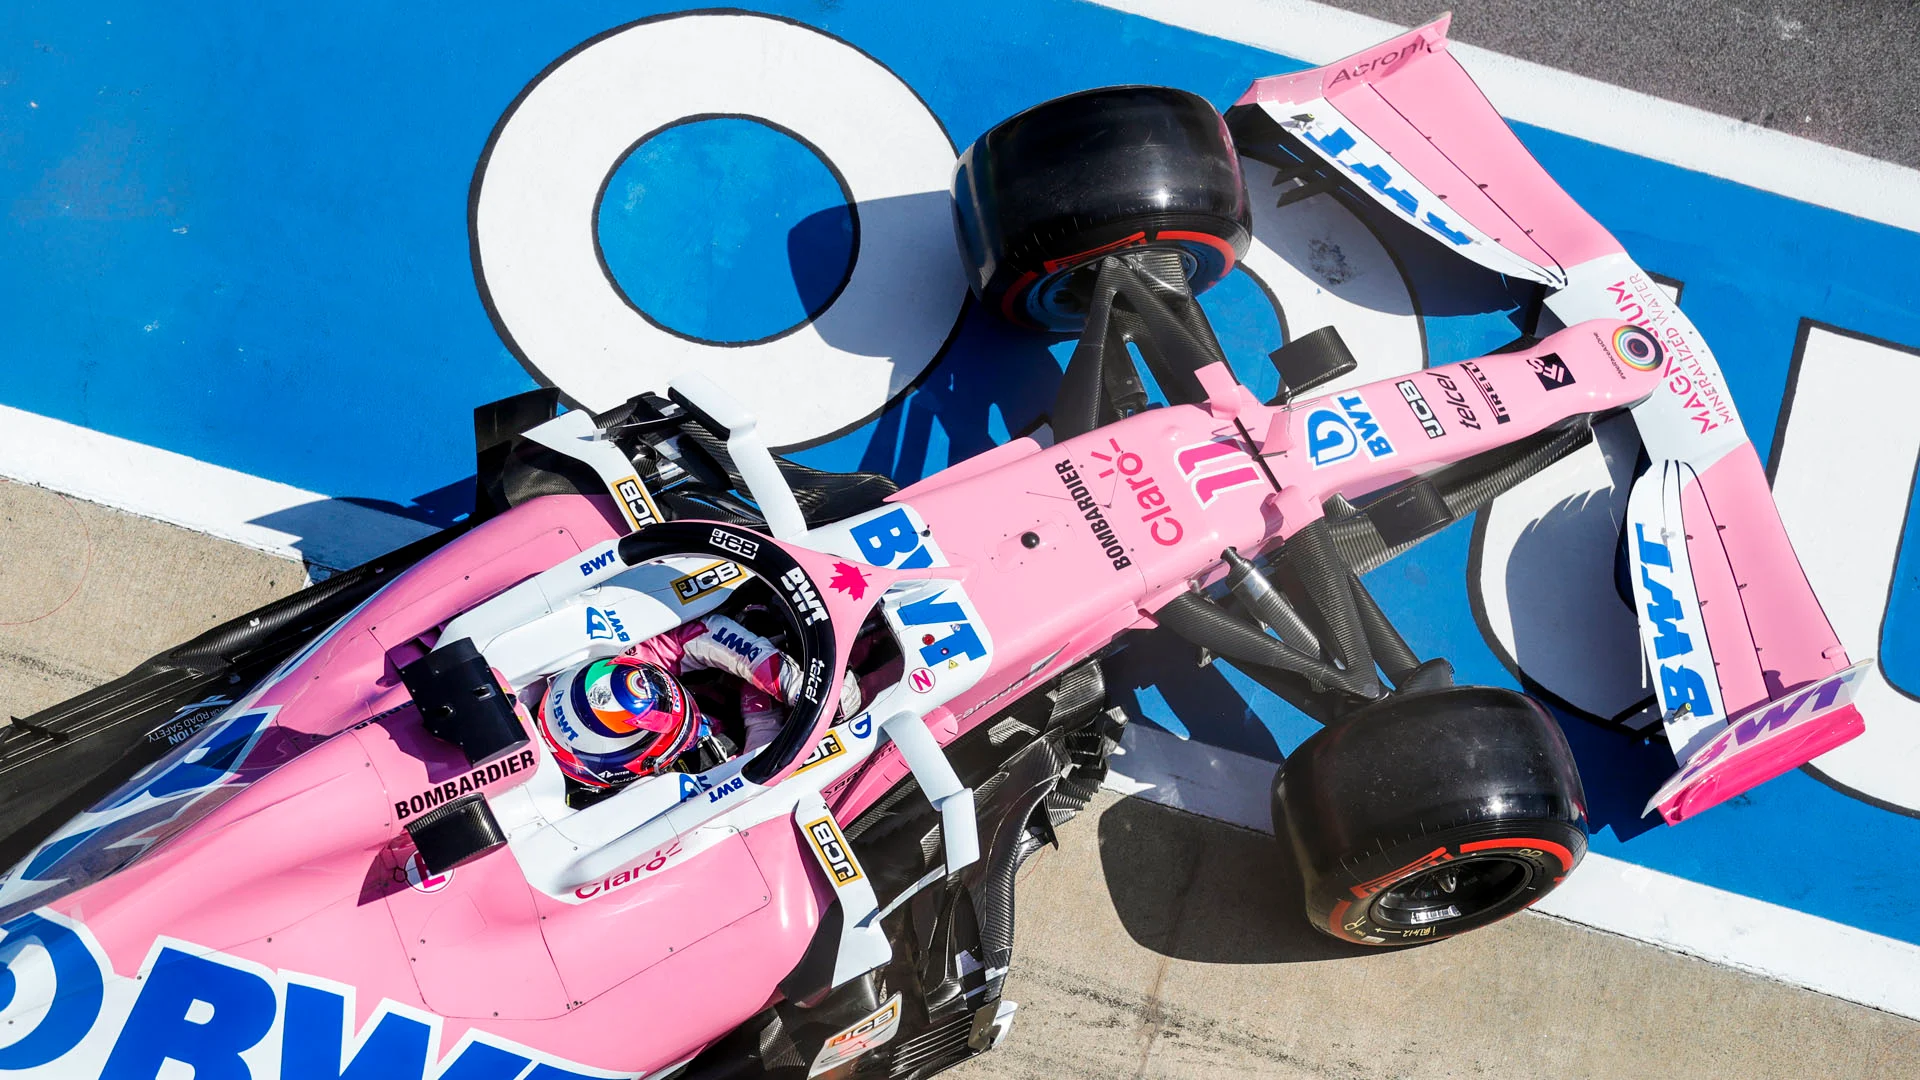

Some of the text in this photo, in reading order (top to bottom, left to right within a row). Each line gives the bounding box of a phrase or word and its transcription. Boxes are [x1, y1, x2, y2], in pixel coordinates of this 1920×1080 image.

[1328, 37, 1432, 89] Acroni
[1629, 273, 1734, 424] MINERALIZED WATER
[1398, 381, 1445, 438] JCB
[1425, 372, 1481, 430] telcel
[1459, 362, 1511, 425] PIRELLI
[1337, 396, 1394, 459] BWT
[1117, 452, 1184, 547] Claro
[1174, 438, 1265, 510] 11
[1055, 458, 1132, 571] BOMBARDIER
[579, 550, 616, 576] BWT
[709, 528, 759, 560] JCB
[681, 562, 740, 598] JCB
[780, 566, 829, 626] BWT
[604, 609, 631, 643] BWT
[1635, 522, 1714, 718] BWT
[804, 657, 826, 705] telcel
[911, 669, 933, 691] N
[148, 723, 182, 743] SAFETY
[184, 712, 210, 725] ROAD
[553, 703, 579, 742] BWT
[1680, 672, 1857, 783] BWT
[394, 750, 536, 820] BOMBARDIER
[708, 777, 745, 803] BWT
[575, 855, 667, 899] Claro
[814, 823, 854, 879] JCB
[838, 1006, 894, 1045] JCB
